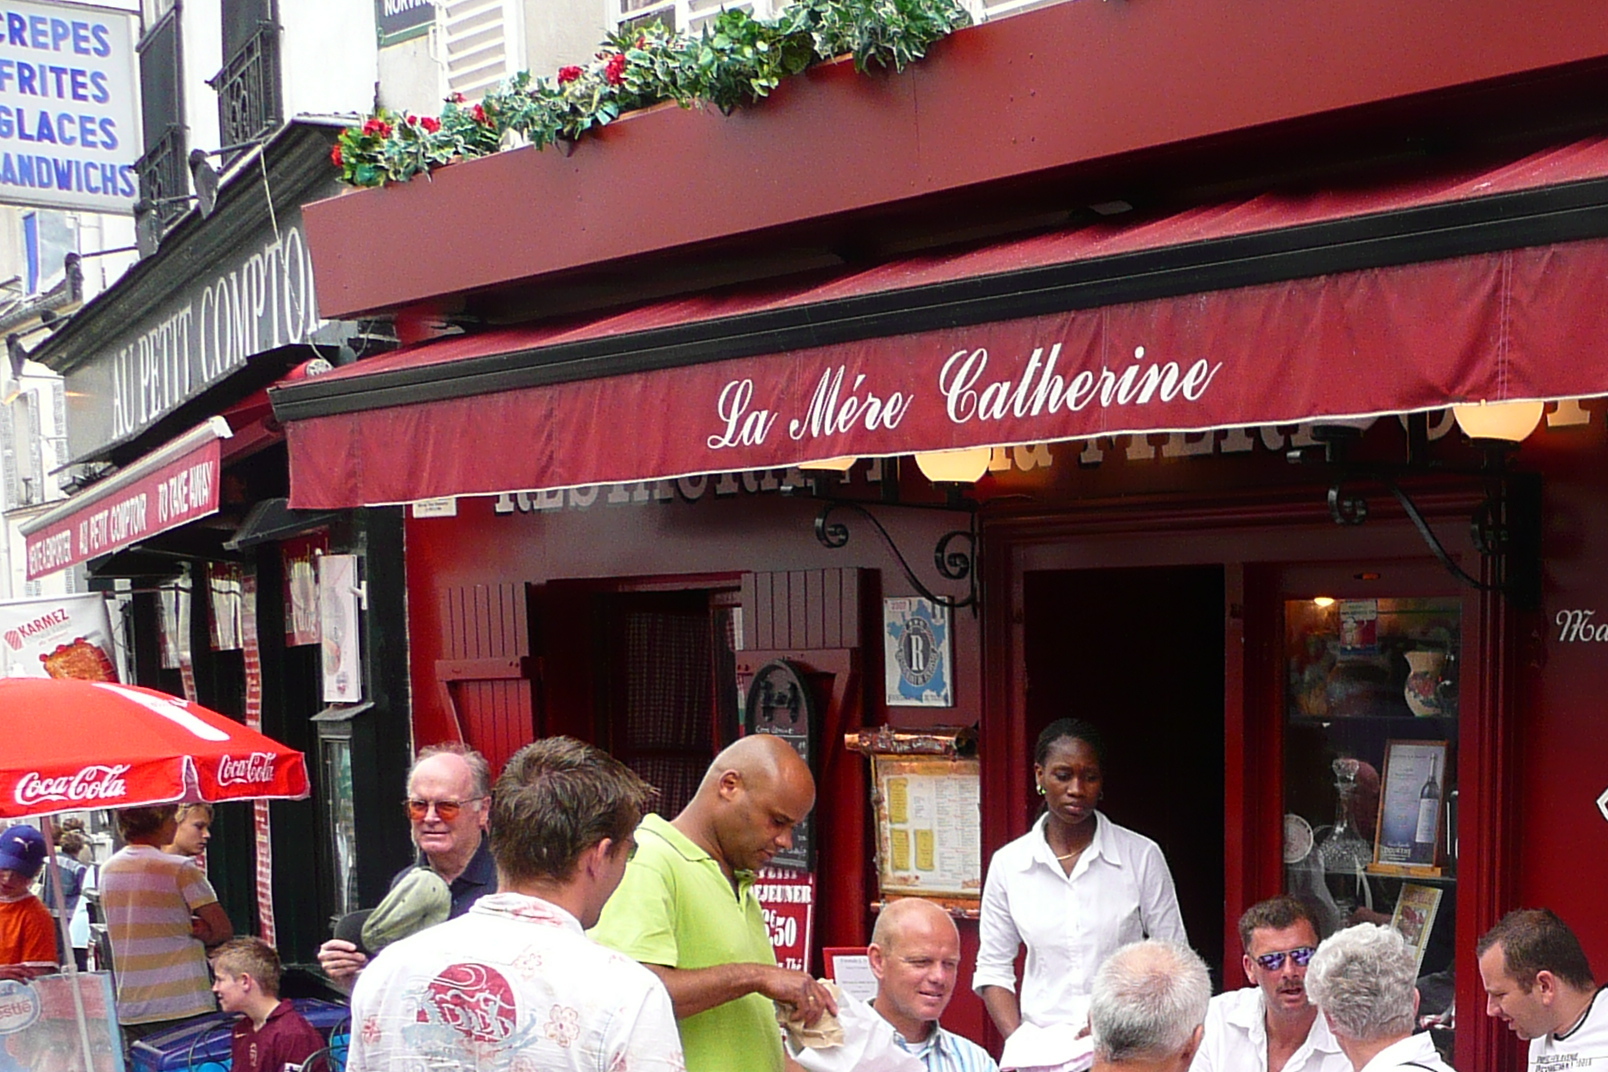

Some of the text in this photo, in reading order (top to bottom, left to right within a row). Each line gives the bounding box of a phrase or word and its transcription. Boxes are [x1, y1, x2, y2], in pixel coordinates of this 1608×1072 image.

[0, 58, 110, 104] FRITES
[0, 105, 118, 151] GLACES
[0, 152, 136, 198] ANDWICHS
[112, 343, 134, 439] AU
[138, 301, 193, 424] PETIT
[707, 342, 1222, 450] La Mére Catherine
[158, 461, 213, 523] TO TAKE AWAY
[17, 608, 69, 639] KARMEZ
[15, 763, 131, 806] Coca-Cola
[217, 752, 276, 787] Coca-Cola
[750, 884, 812, 904] EJEUNER
